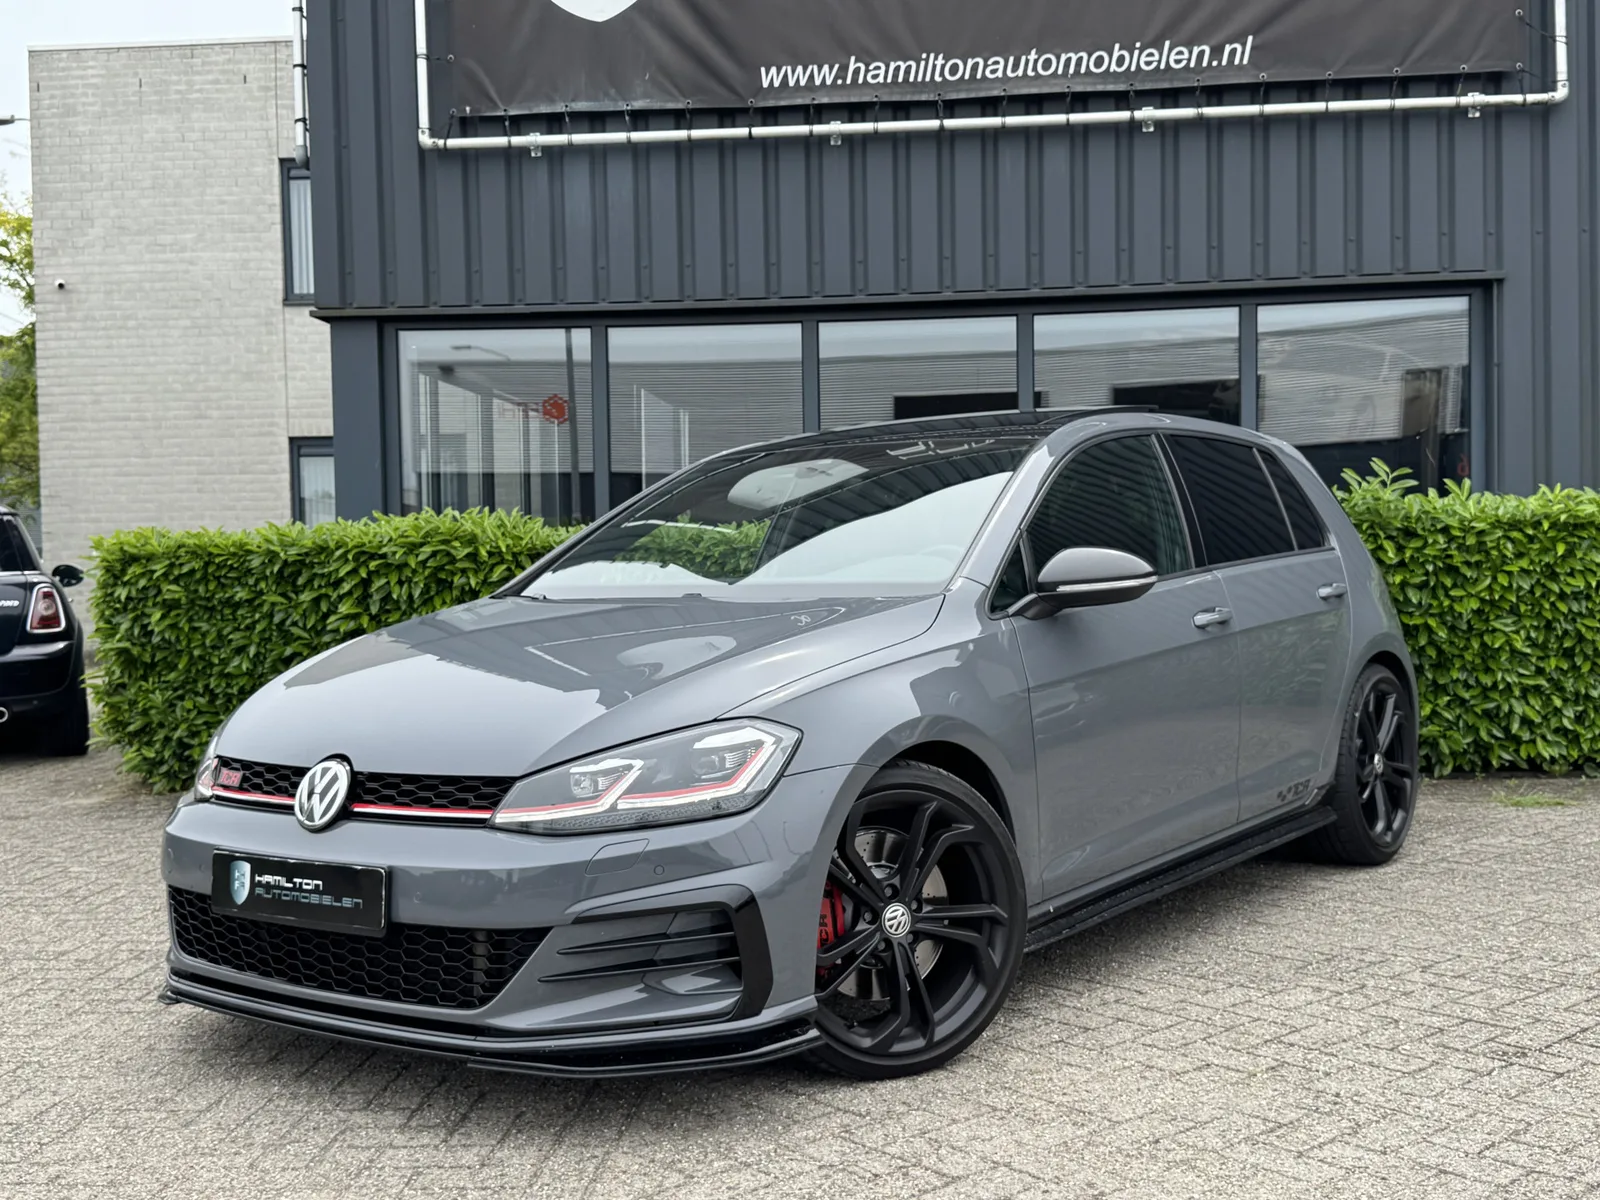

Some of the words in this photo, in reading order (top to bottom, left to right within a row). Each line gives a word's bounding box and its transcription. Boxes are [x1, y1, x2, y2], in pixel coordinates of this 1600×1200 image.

[760, 35, 1254, 88] www.hamiltonautomobielen.nl
[255, 873, 323, 891] HAMILTON
[254, 887, 363, 909] AUTOMOBIELEN
